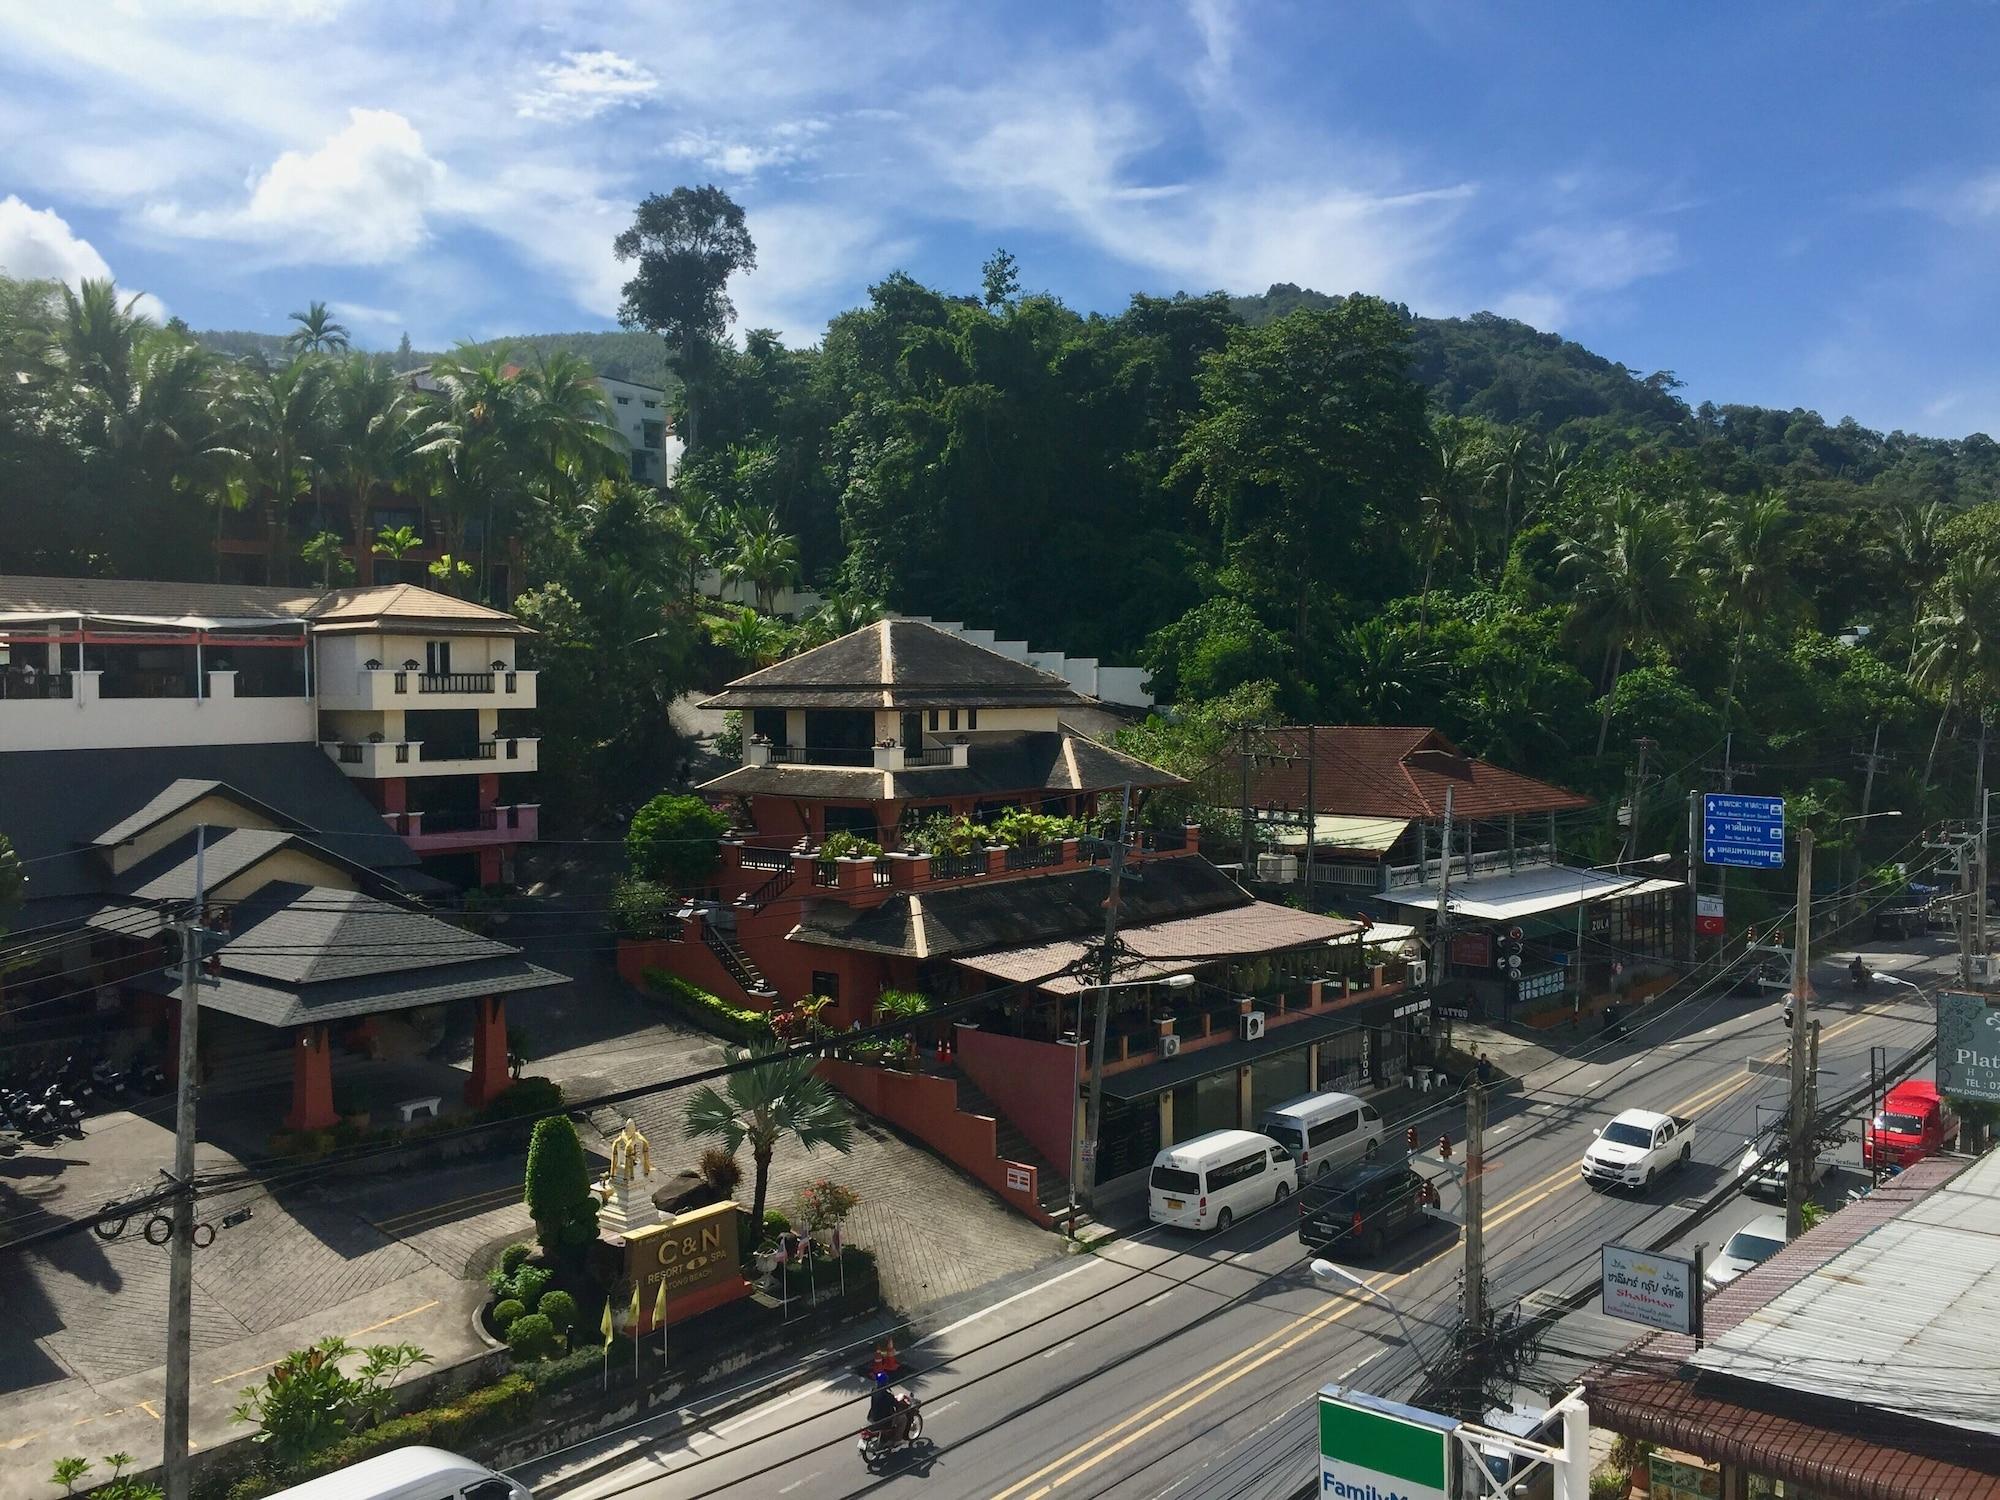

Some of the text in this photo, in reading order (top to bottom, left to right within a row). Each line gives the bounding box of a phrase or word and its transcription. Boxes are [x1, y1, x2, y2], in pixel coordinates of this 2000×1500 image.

[1591, 919, 1610, 931] ZULA
[1437, 1006, 1469, 1018] TATTOO
[647, 1249, 727, 1285] RESORT SPA
[1616, 1288, 1675, 1310] Shalimar
[1661, 1284, 1684, 1300] จำกัด
